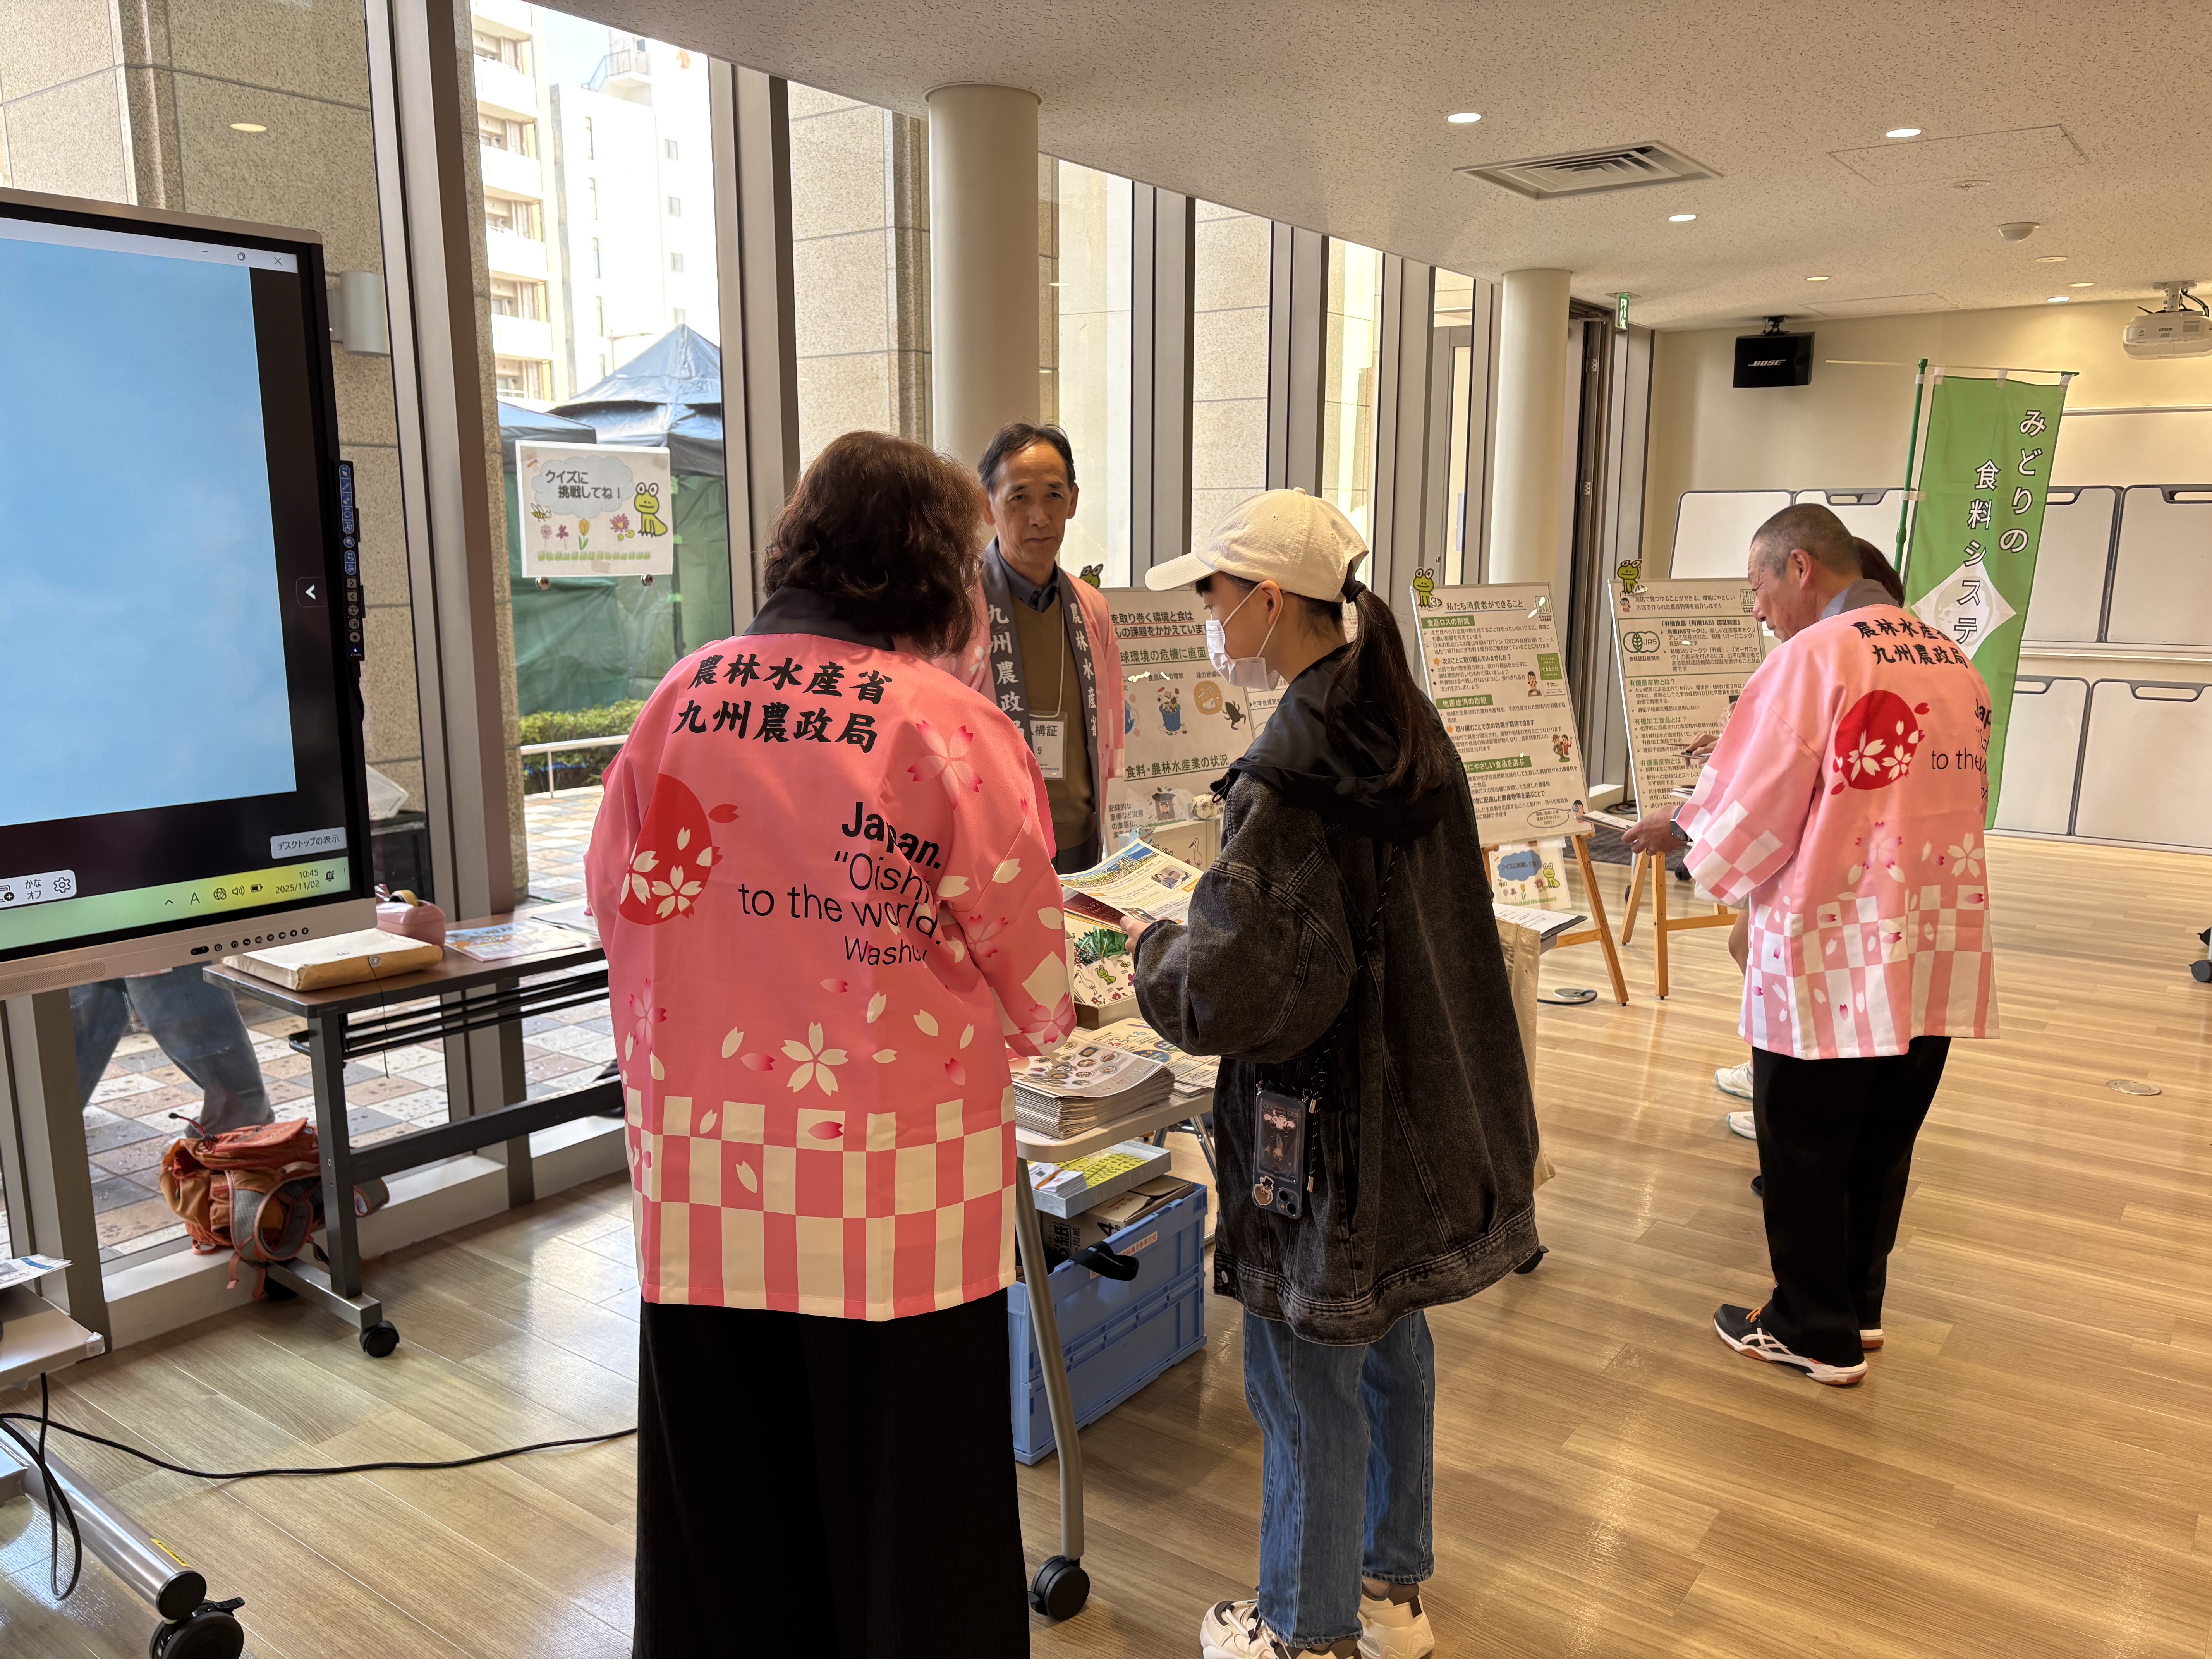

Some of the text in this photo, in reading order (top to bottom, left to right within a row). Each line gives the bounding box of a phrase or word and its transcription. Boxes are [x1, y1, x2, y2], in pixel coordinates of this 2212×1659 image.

[546, 469, 589, 484] クイズに
[1999, 409, 2047, 554] みどりの
[558, 485, 621, 499] 挑戦してね！
[1954, 459, 2002, 644] 食料システ
[1431, 597, 1437, 607] 3
[1447, 599, 1523, 611] 私たち消費者ができること
[1111, 611, 1194, 624] を取り巻く環境と食は
[1427, 617, 1470, 627] 食品ロスの削減
[1872, 643, 1968, 668] 九州農政局
[687, 654, 893, 705] 農林水産省
[1148, 672, 1183, 682] 食品ロの増加
[1630, 678, 1675, 687] 有機農産物とは？
[1443, 697, 1487, 707] 地産地消の取組
[671, 699, 879, 754] 九州農政局
[1635, 717, 1686, 725] 有機加工食品とは？
[1030, 725, 1057, 736] 構証
[1125, 754, 1229, 778] 食料・農林水産業の状況
[1932, 750, 1948, 770] to
[1109, 803, 1132, 812] 記録的な
[1110, 809, 1143, 821] 豪雨など災害
[842, 801, 941, 869] Japan.
[278, 834, 340, 851] デスクトップの表示
[299, 869, 319, 879] 10:45
[24, 879, 41, 888] かな
[275, 880, 320, 894] 2025/11/02
[27, 889, 41, 900] オフ
[190, 891, 201, 906] A
[738, 883, 941, 946] to the world.
